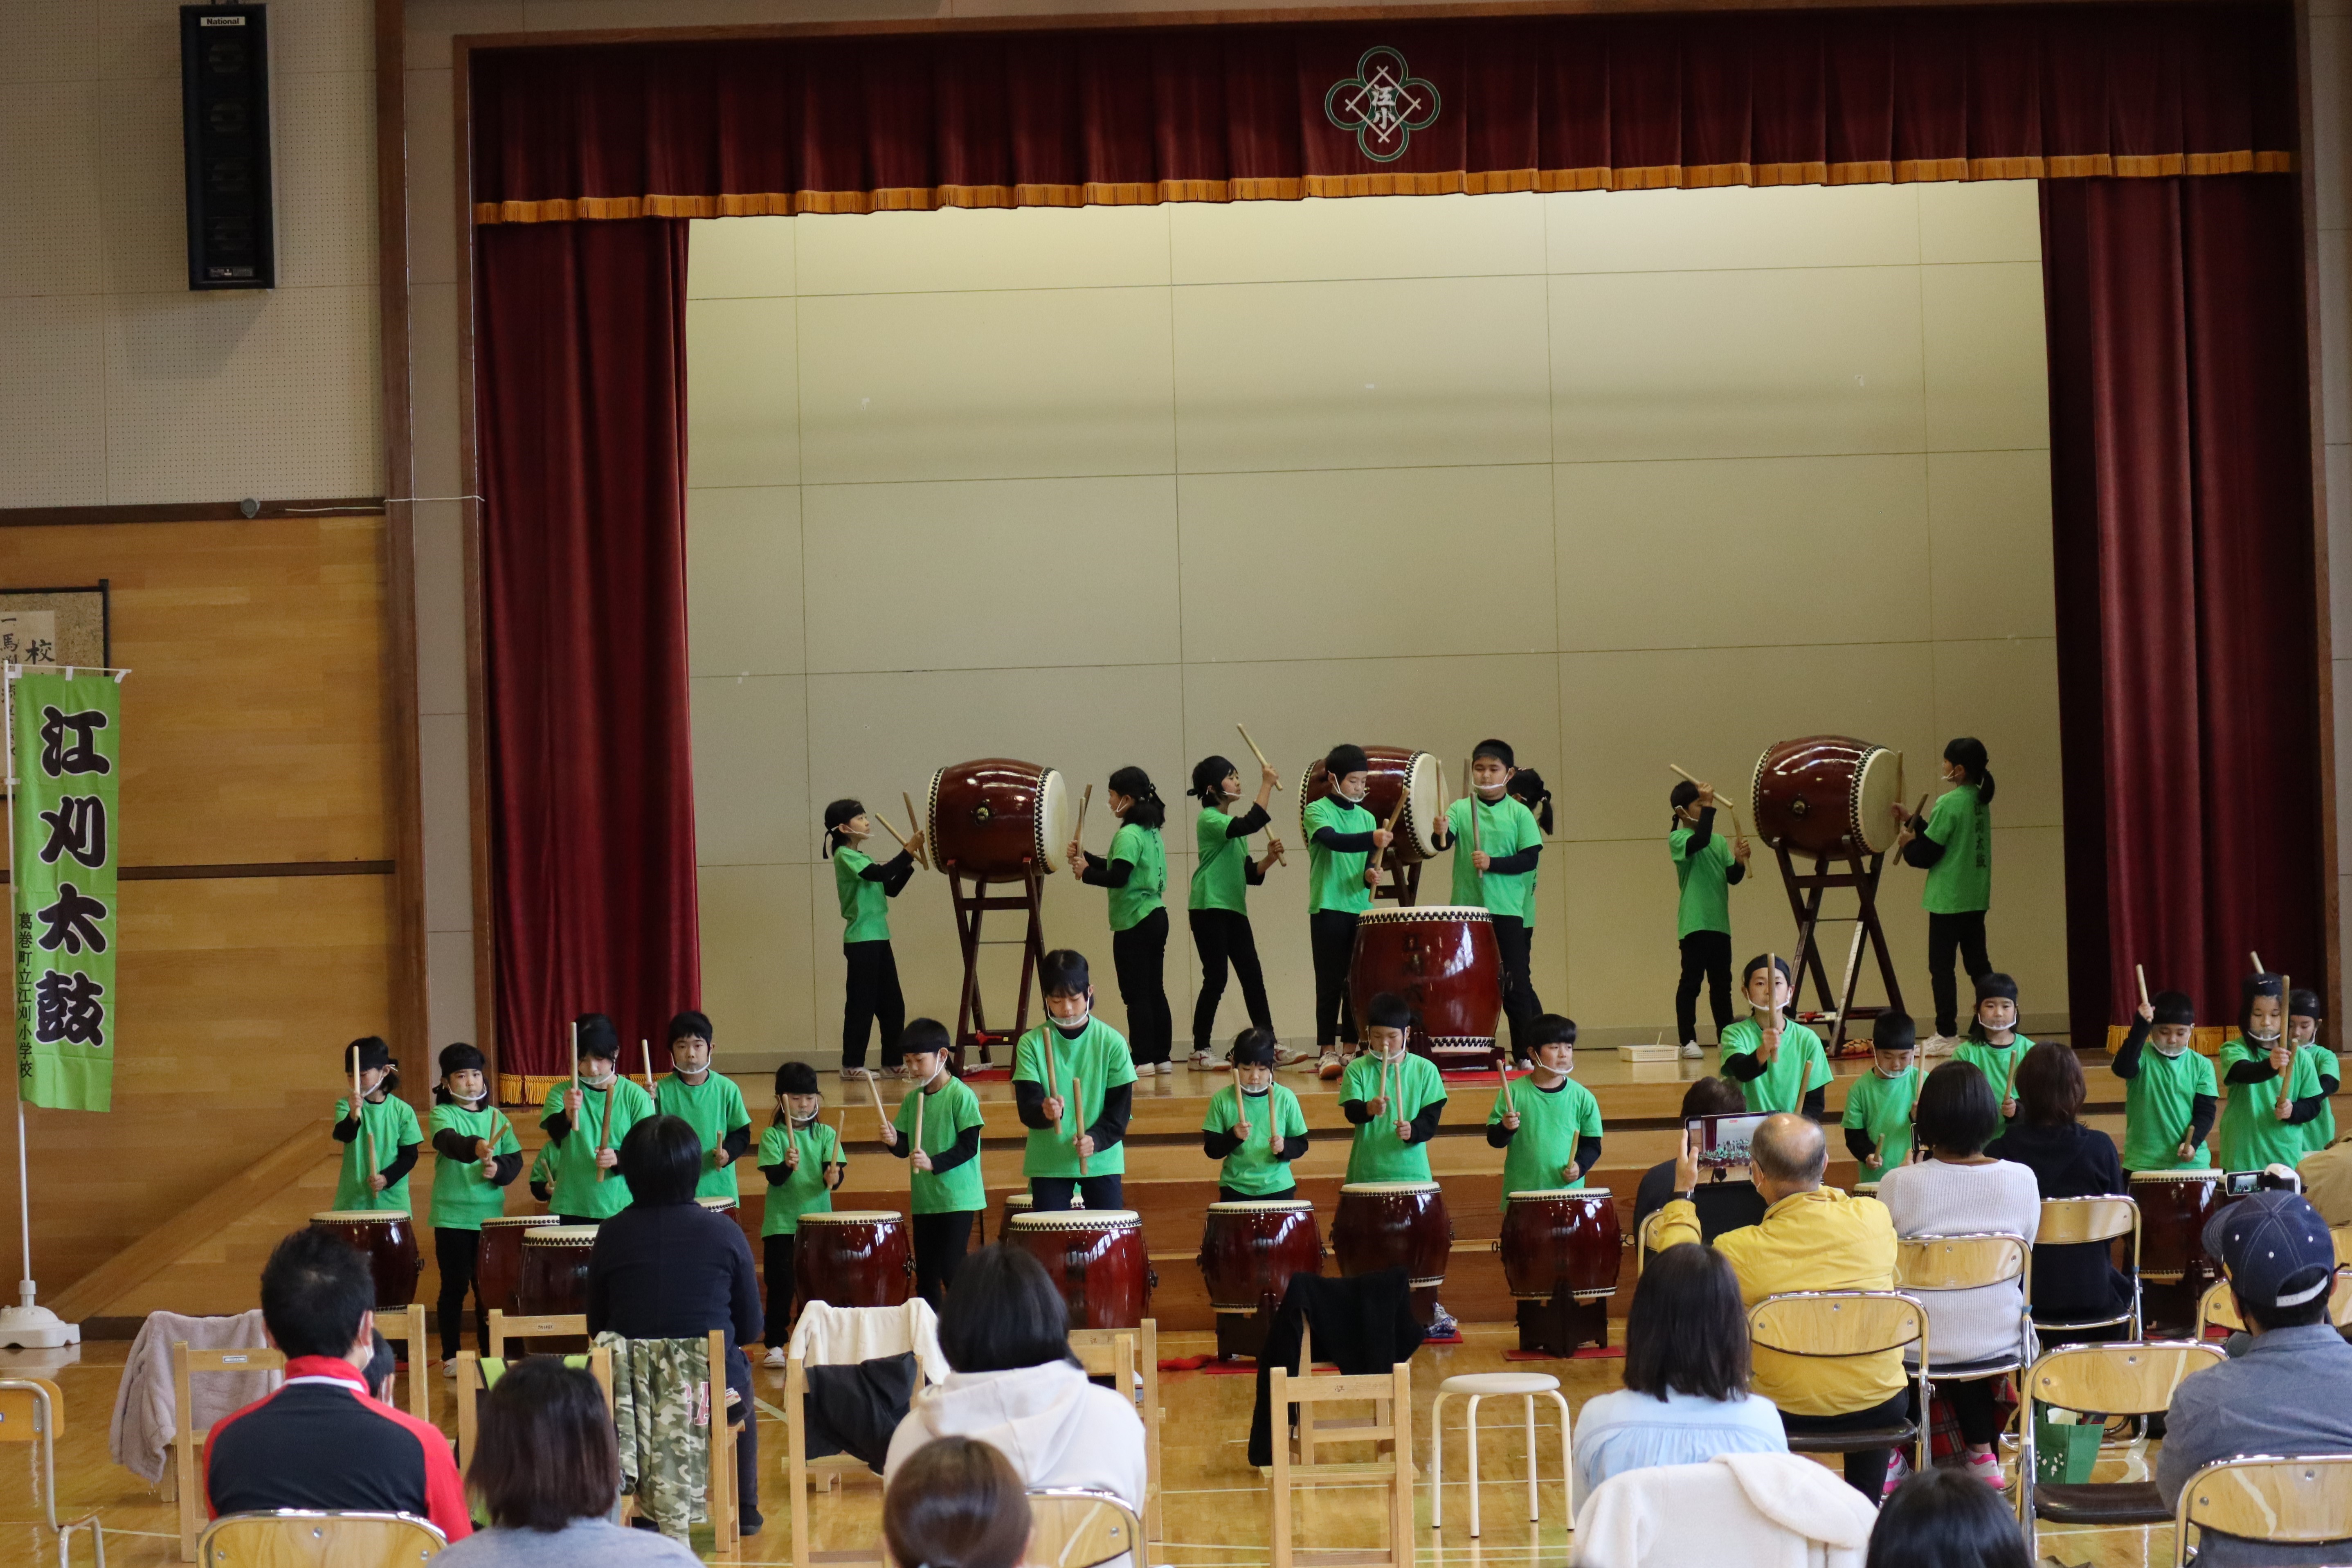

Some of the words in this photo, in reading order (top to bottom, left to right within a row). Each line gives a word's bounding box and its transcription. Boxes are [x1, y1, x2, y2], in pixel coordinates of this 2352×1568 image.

[1371, 83, 1396, 130] 江小
[35, 705, 110, 1046] 江刈太鼓
[18, 912, 33, 1078] 葛巻町立江刈小学校
